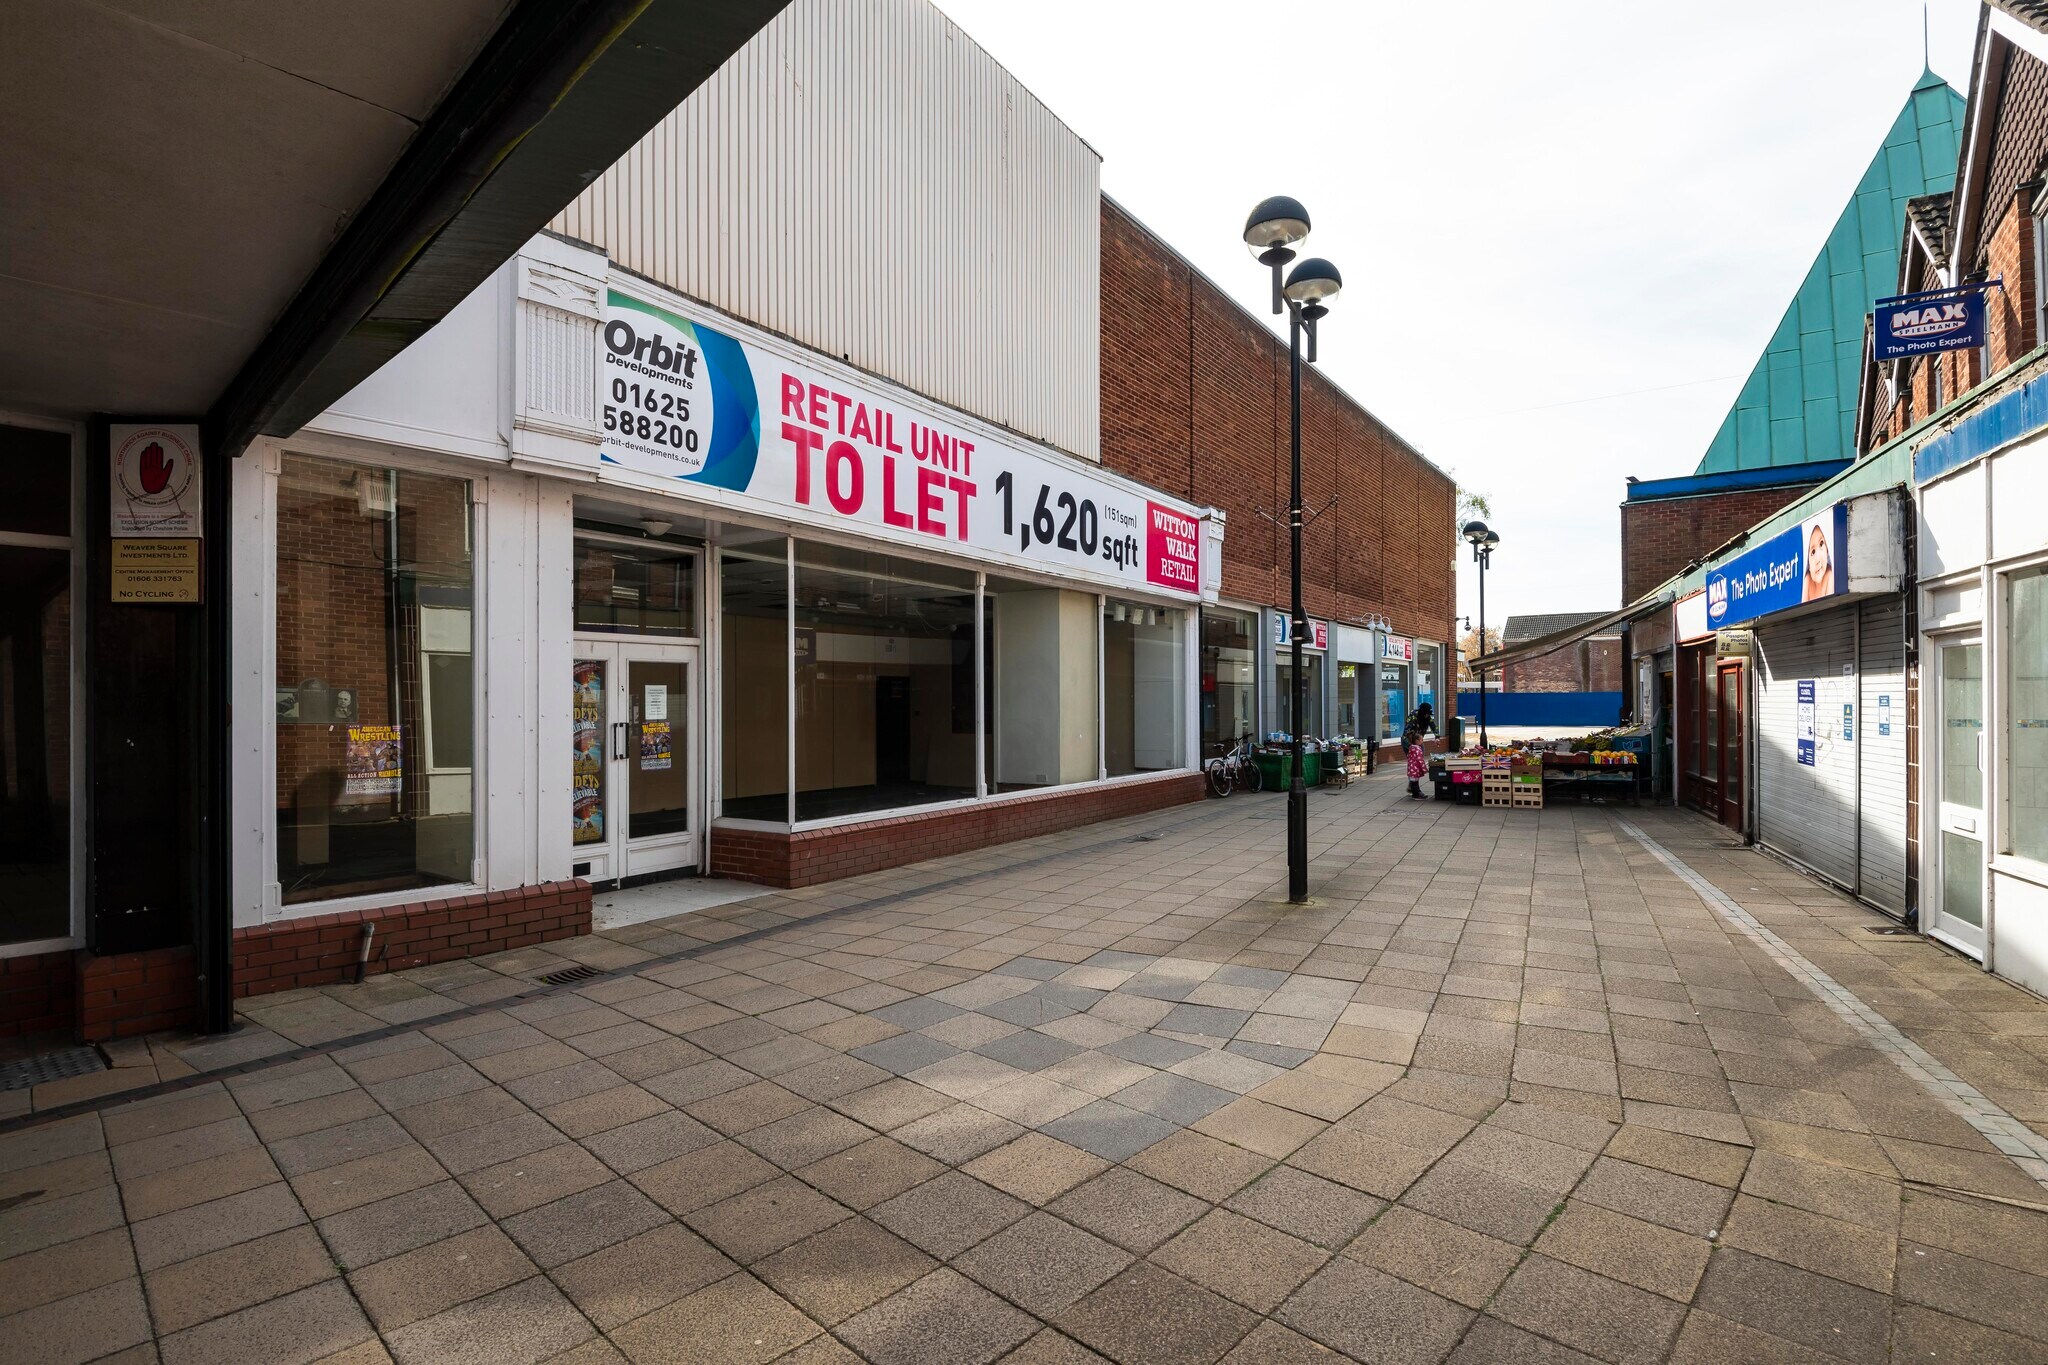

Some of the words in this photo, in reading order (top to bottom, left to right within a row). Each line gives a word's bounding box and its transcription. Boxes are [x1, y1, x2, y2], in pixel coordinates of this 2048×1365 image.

[1892, 303, 1966, 328] MAX
[1899, 322, 1959, 335] SPIELMANN
[604, 319, 698, 379] Orbit
[1887, 346, 1905, 354] The
[1908, 342, 1936, 351] Photo
[1939, 336, 1972, 348] Expert
[606, 352, 693, 390] Developments
[612, 378, 690, 422] 01625
[604, 405, 698, 453] 588200
[782, 373, 903, 454] RETAIL
[911, 422, 974, 476] UNIT
[782, 422, 864, 515] TO
[883, 455, 977, 542] LET
[995, 470, 1098, 556] 1,620
[1103, 535, 1138, 571] sqft
[1104, 505, 1137, 528] (151sqm)
[1153, 509, 1195, 541] WITTON
[1166, 537, 1196, 562] WALK
[1161, 558, 1195, 583] RETAIL
[1731, 577, 1744, 602] The
[1746, 568, 1767, 595] Photo
[1769, 552, 1799, 590] Expert
[1709, 578, 1727, 604] MAX
[348, 729, 401, 742] WRESTLING
